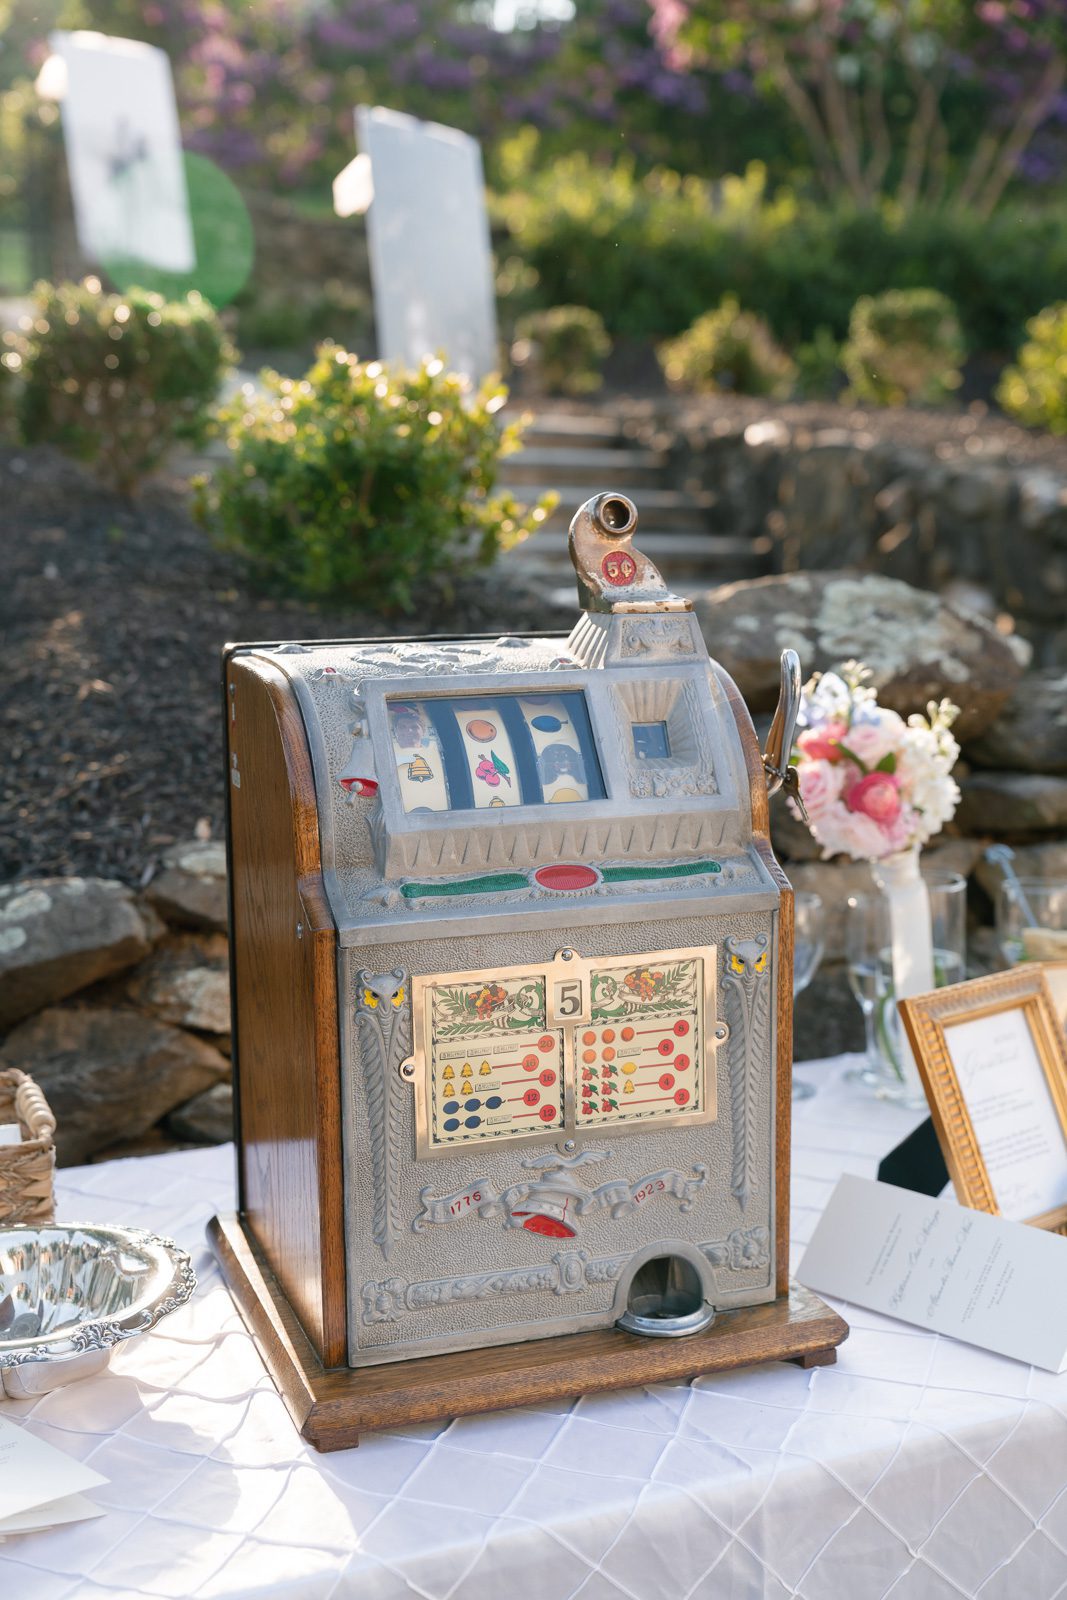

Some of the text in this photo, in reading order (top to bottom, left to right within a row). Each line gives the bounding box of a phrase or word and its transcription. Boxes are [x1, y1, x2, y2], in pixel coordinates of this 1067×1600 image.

[559, 985, 581, 1015] 5
[540, 1039, 553, 1048] 20
[543, 1074, 554, 1082] 16
[526, 1093, 537, 1102] 12
[543, 1108, 554, 1117] 12
[633, 1179, 666, 1203] 1923
[449, 1190, 482, 1215] 1776
